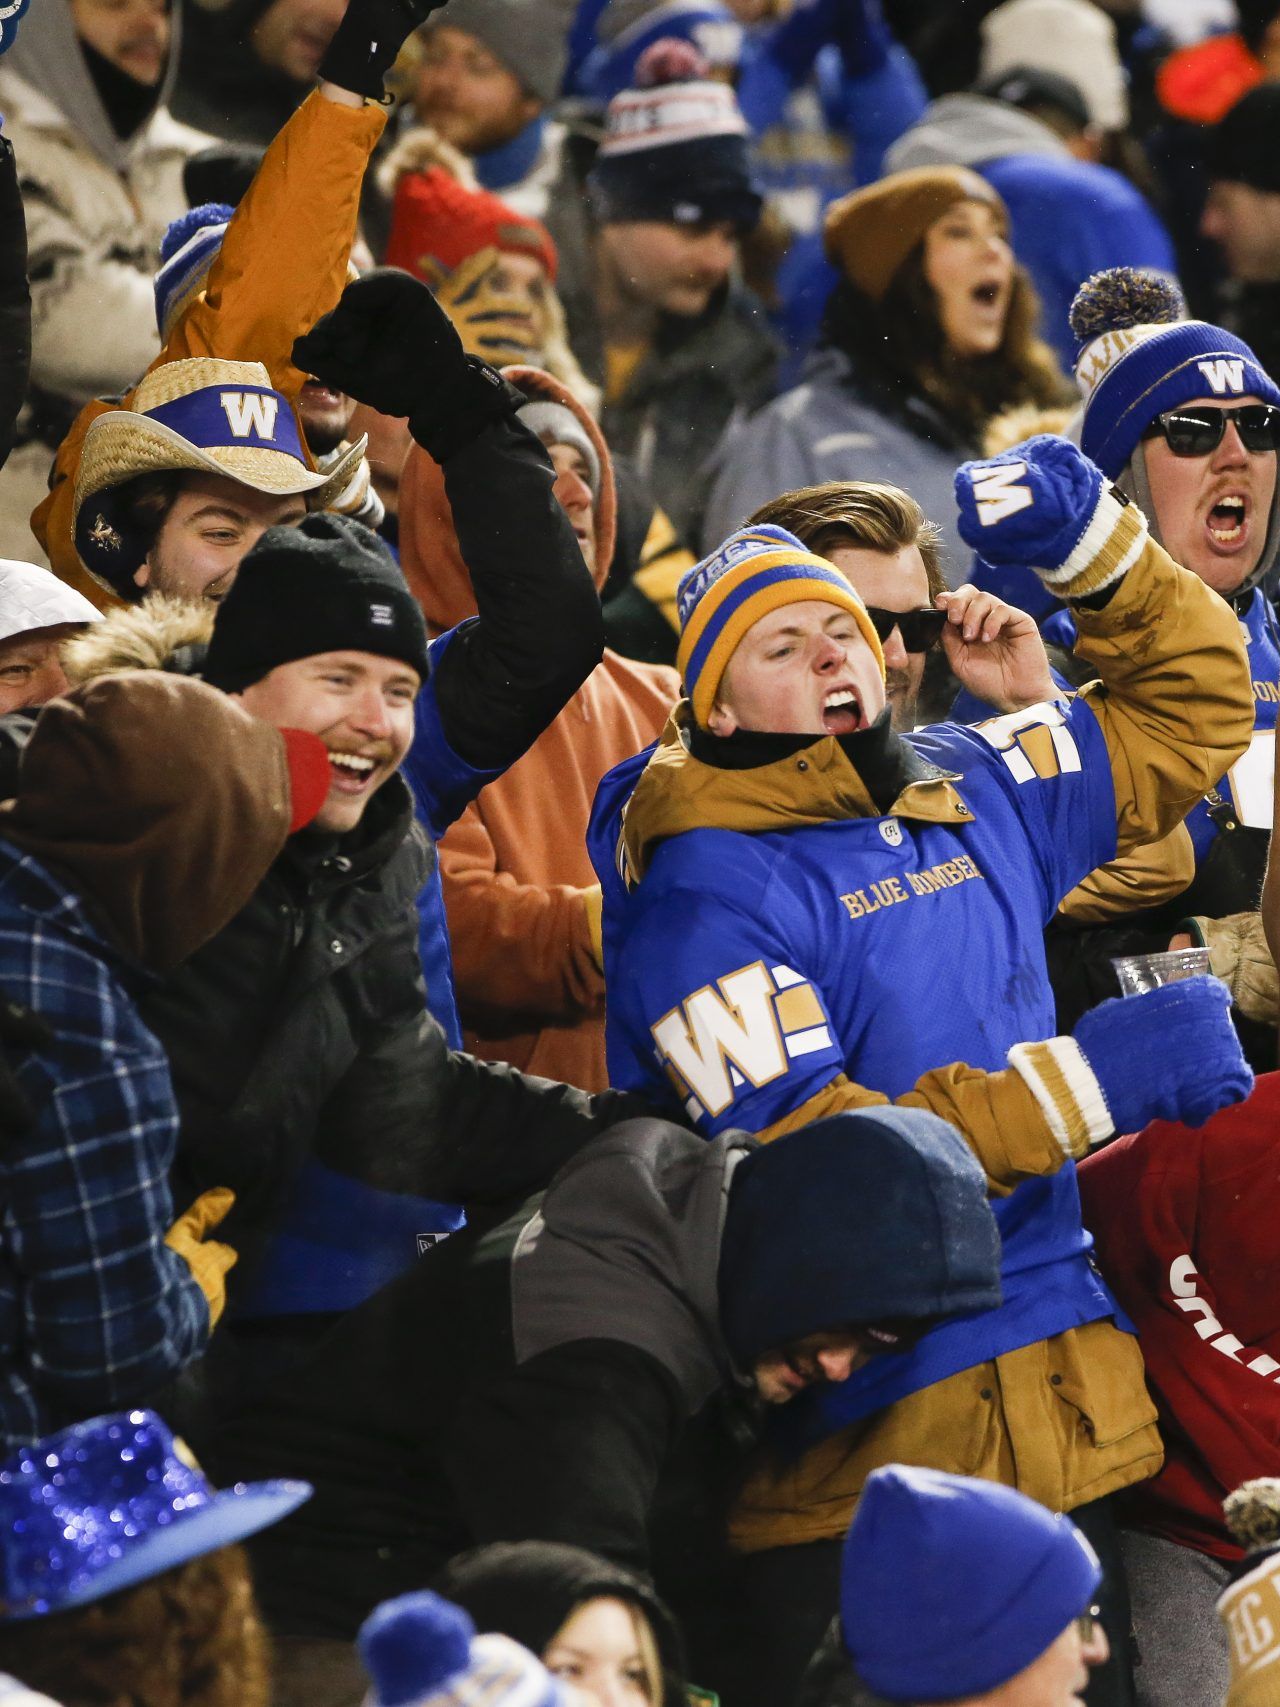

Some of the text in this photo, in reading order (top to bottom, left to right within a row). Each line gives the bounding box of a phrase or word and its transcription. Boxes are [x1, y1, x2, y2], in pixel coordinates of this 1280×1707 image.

[1197, 360, 1245, 393] W
[220, 391, 279, 441] W
[884, 824, 898, 838] CFL
[839, 876, 910, 920] BLUE
[650, 959, 788, 1119] W
